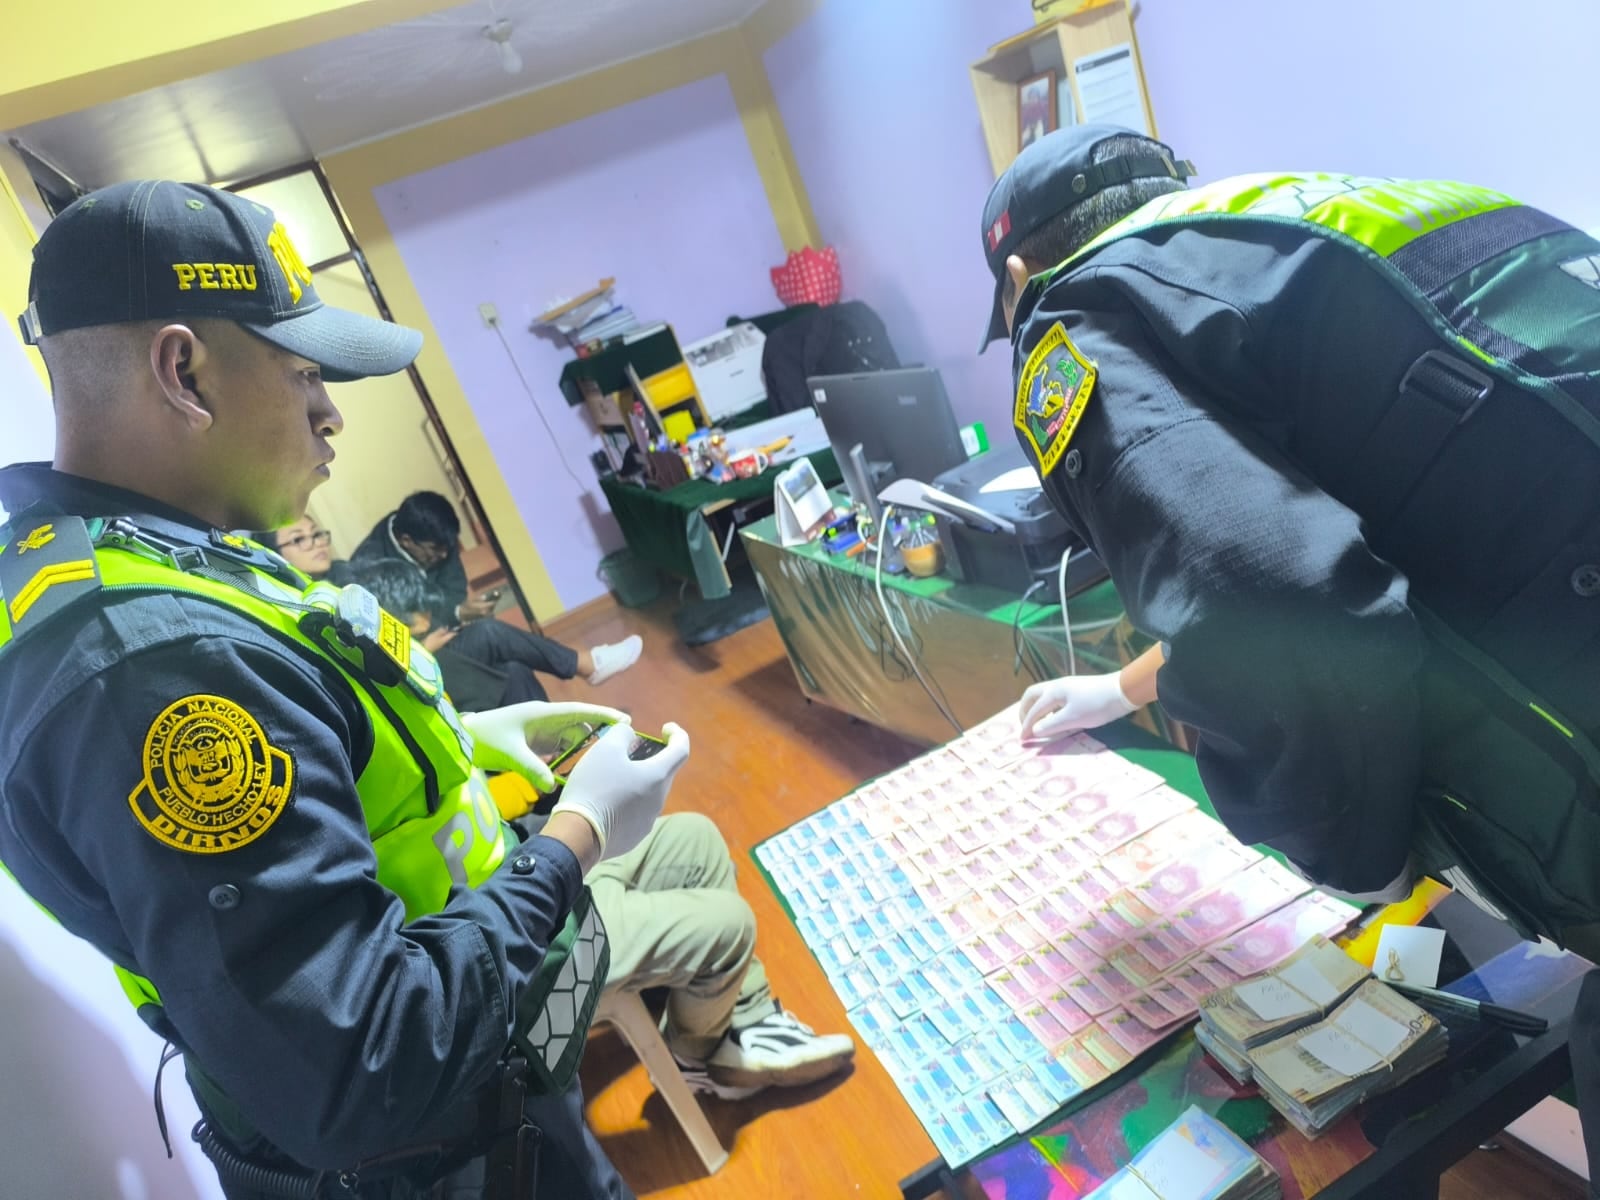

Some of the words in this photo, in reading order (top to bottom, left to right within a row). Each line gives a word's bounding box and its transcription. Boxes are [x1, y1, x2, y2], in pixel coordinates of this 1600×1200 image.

[172, 263, 257, 290] PERU
[150, 711, 183, 769] POLICIA
[187, 701, 257, 744] NACIONAL
[151, 785, 284, 848] DIRNOS
[158, 786, 209, 825] PUEBLO
[212, 788, 258, 825] HECHO
[252, 761, 267, 788] LEY
